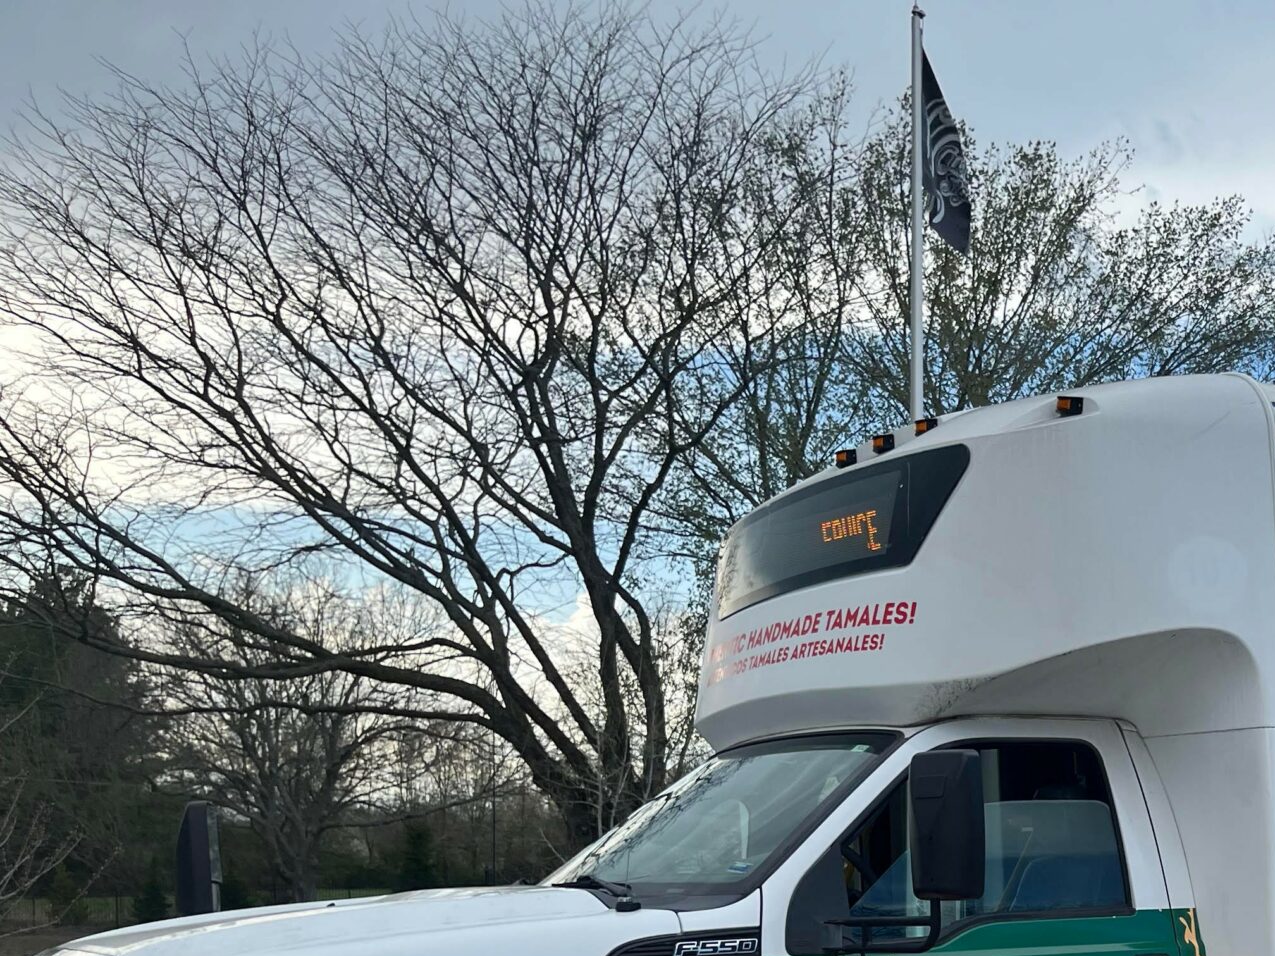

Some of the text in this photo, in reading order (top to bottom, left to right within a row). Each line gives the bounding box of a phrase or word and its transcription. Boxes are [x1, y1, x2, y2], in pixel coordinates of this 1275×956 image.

[747, 613, 822, 651] HANDMADE
[825, 602, 917, 631] TAMALES!
[748, 646, 790, 671] TAMALES
[790, 633, 885, 661] ARTESANALES!
[673, 938, 758, 956] F-550
